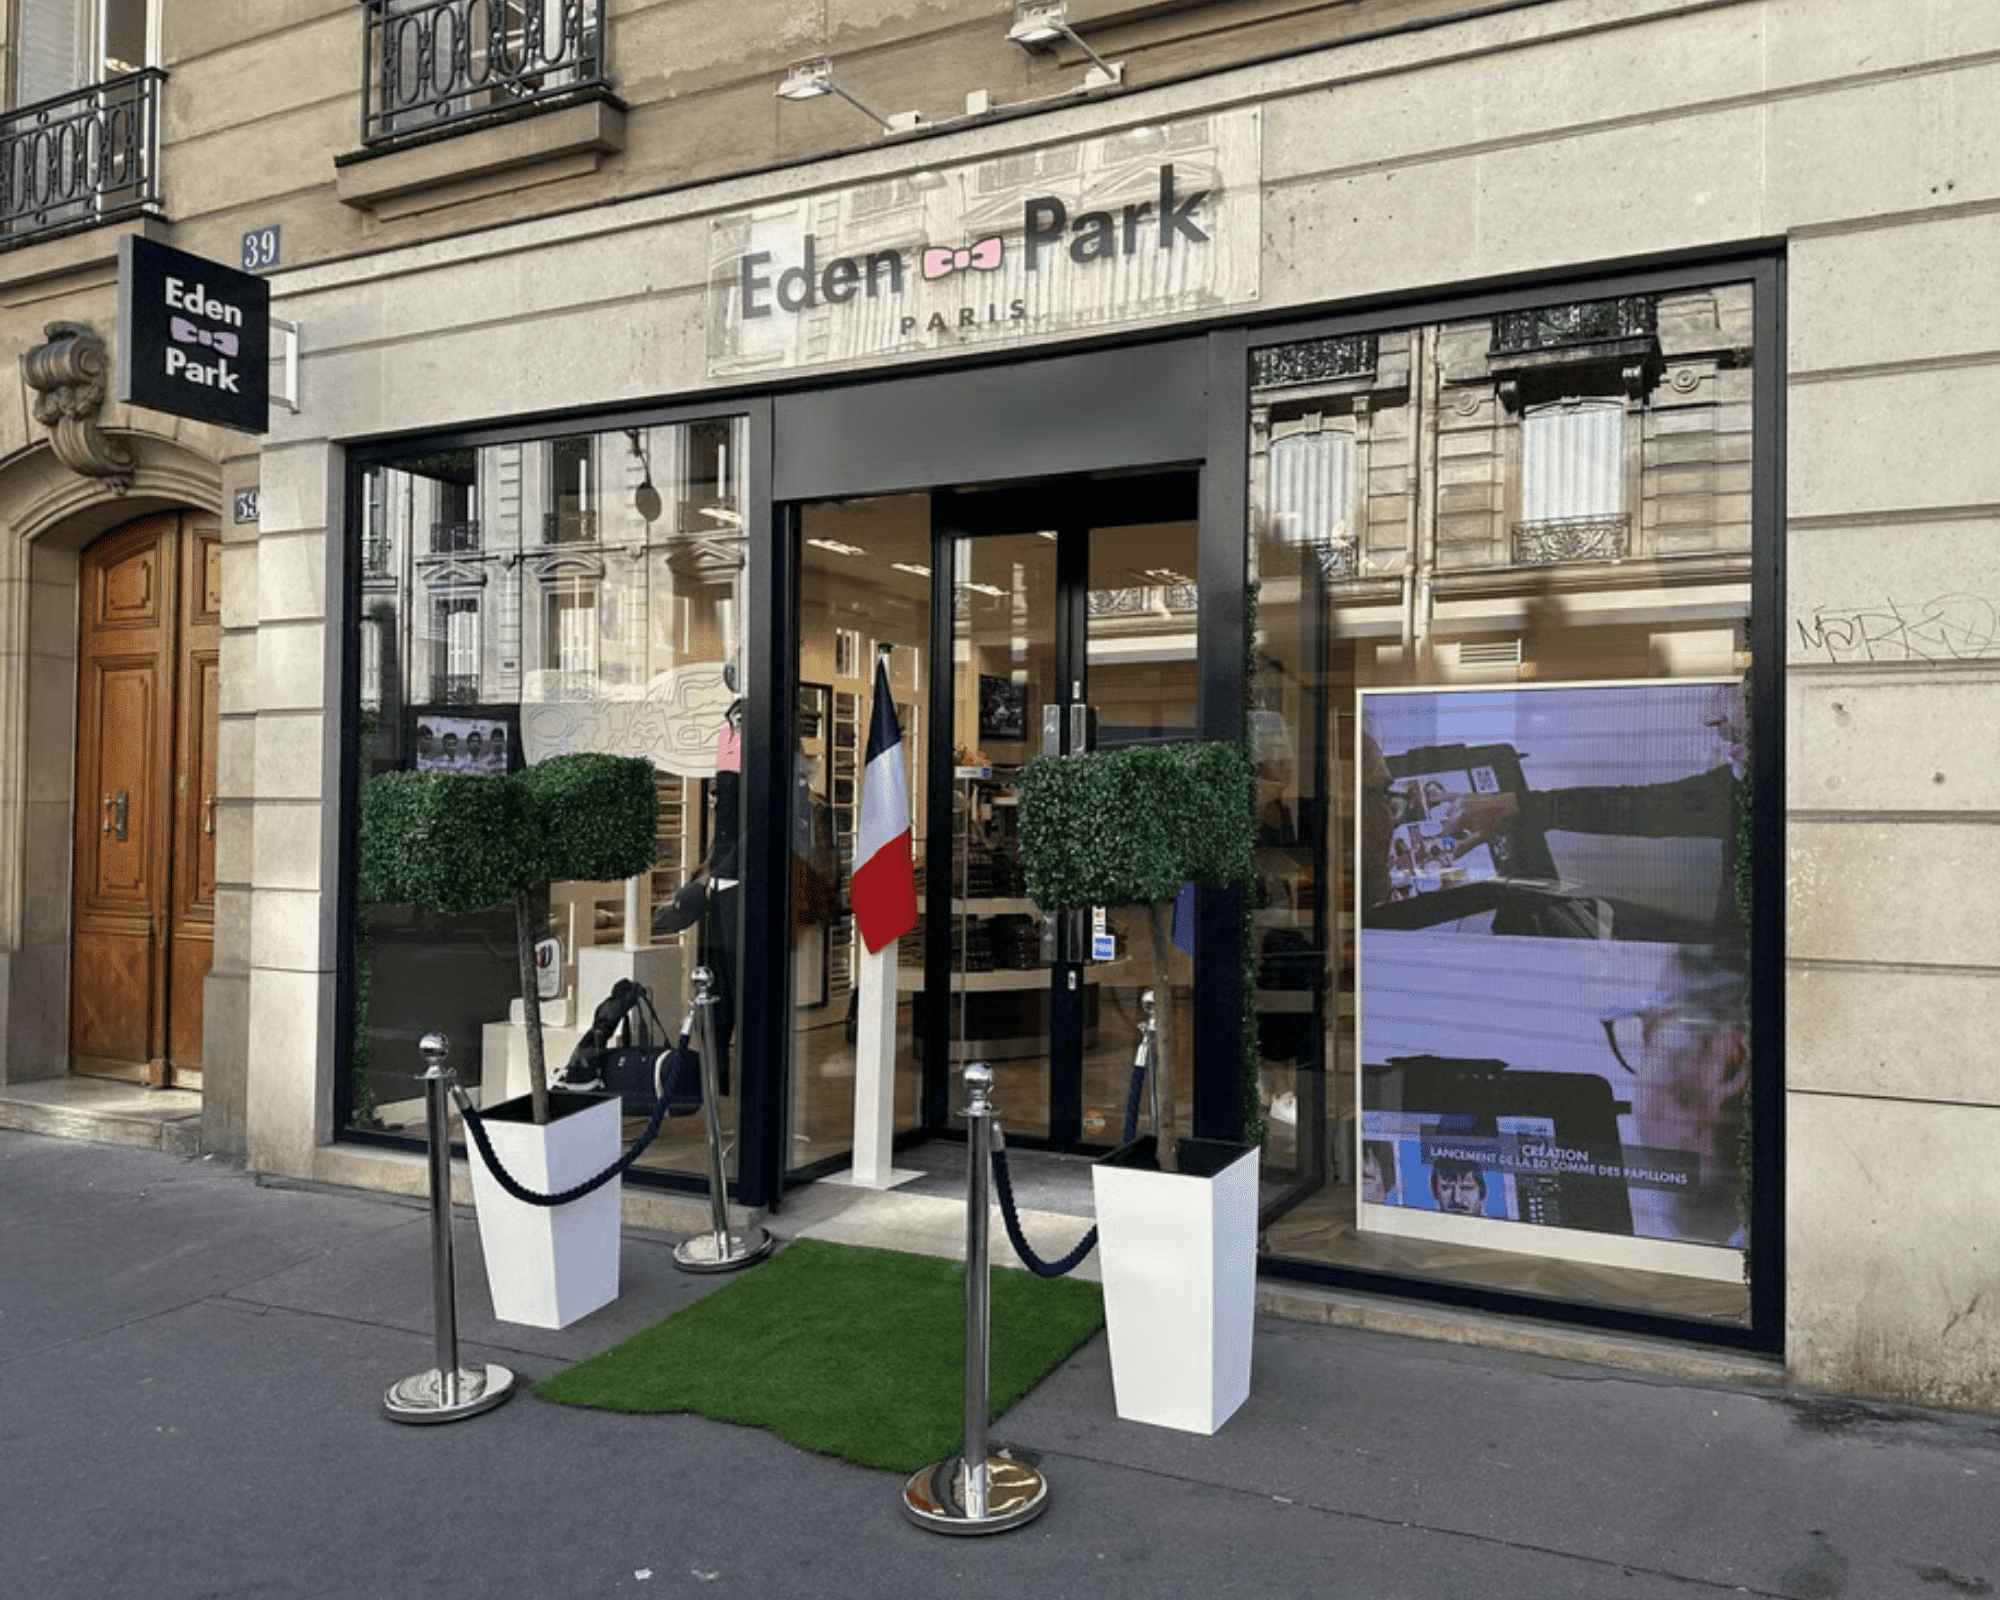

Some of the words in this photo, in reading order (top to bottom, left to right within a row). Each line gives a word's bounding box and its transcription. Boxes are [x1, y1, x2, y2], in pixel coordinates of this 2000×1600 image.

[244, 230, 276, 267] 39
[742, 233, 903, 319] Eden
[1024, 164, 1210, 271] Park
[165, 276, 242, 328] Eden
[900, 299, 1027, 336] PARIS
[165, 346, 240, 393] Park
[1430, 1147, 1497, 1164] LANCEMENT
[1515, 1157, 1531, 1168] LA
[1551, 1161, 1596, 1174] COMME
[1598, 1166, 1621, 1178] DES
[1623, 1168, 1688, 1185] PAPILLONS
[1521, 1142, 1589, 1163] CRÉATION
